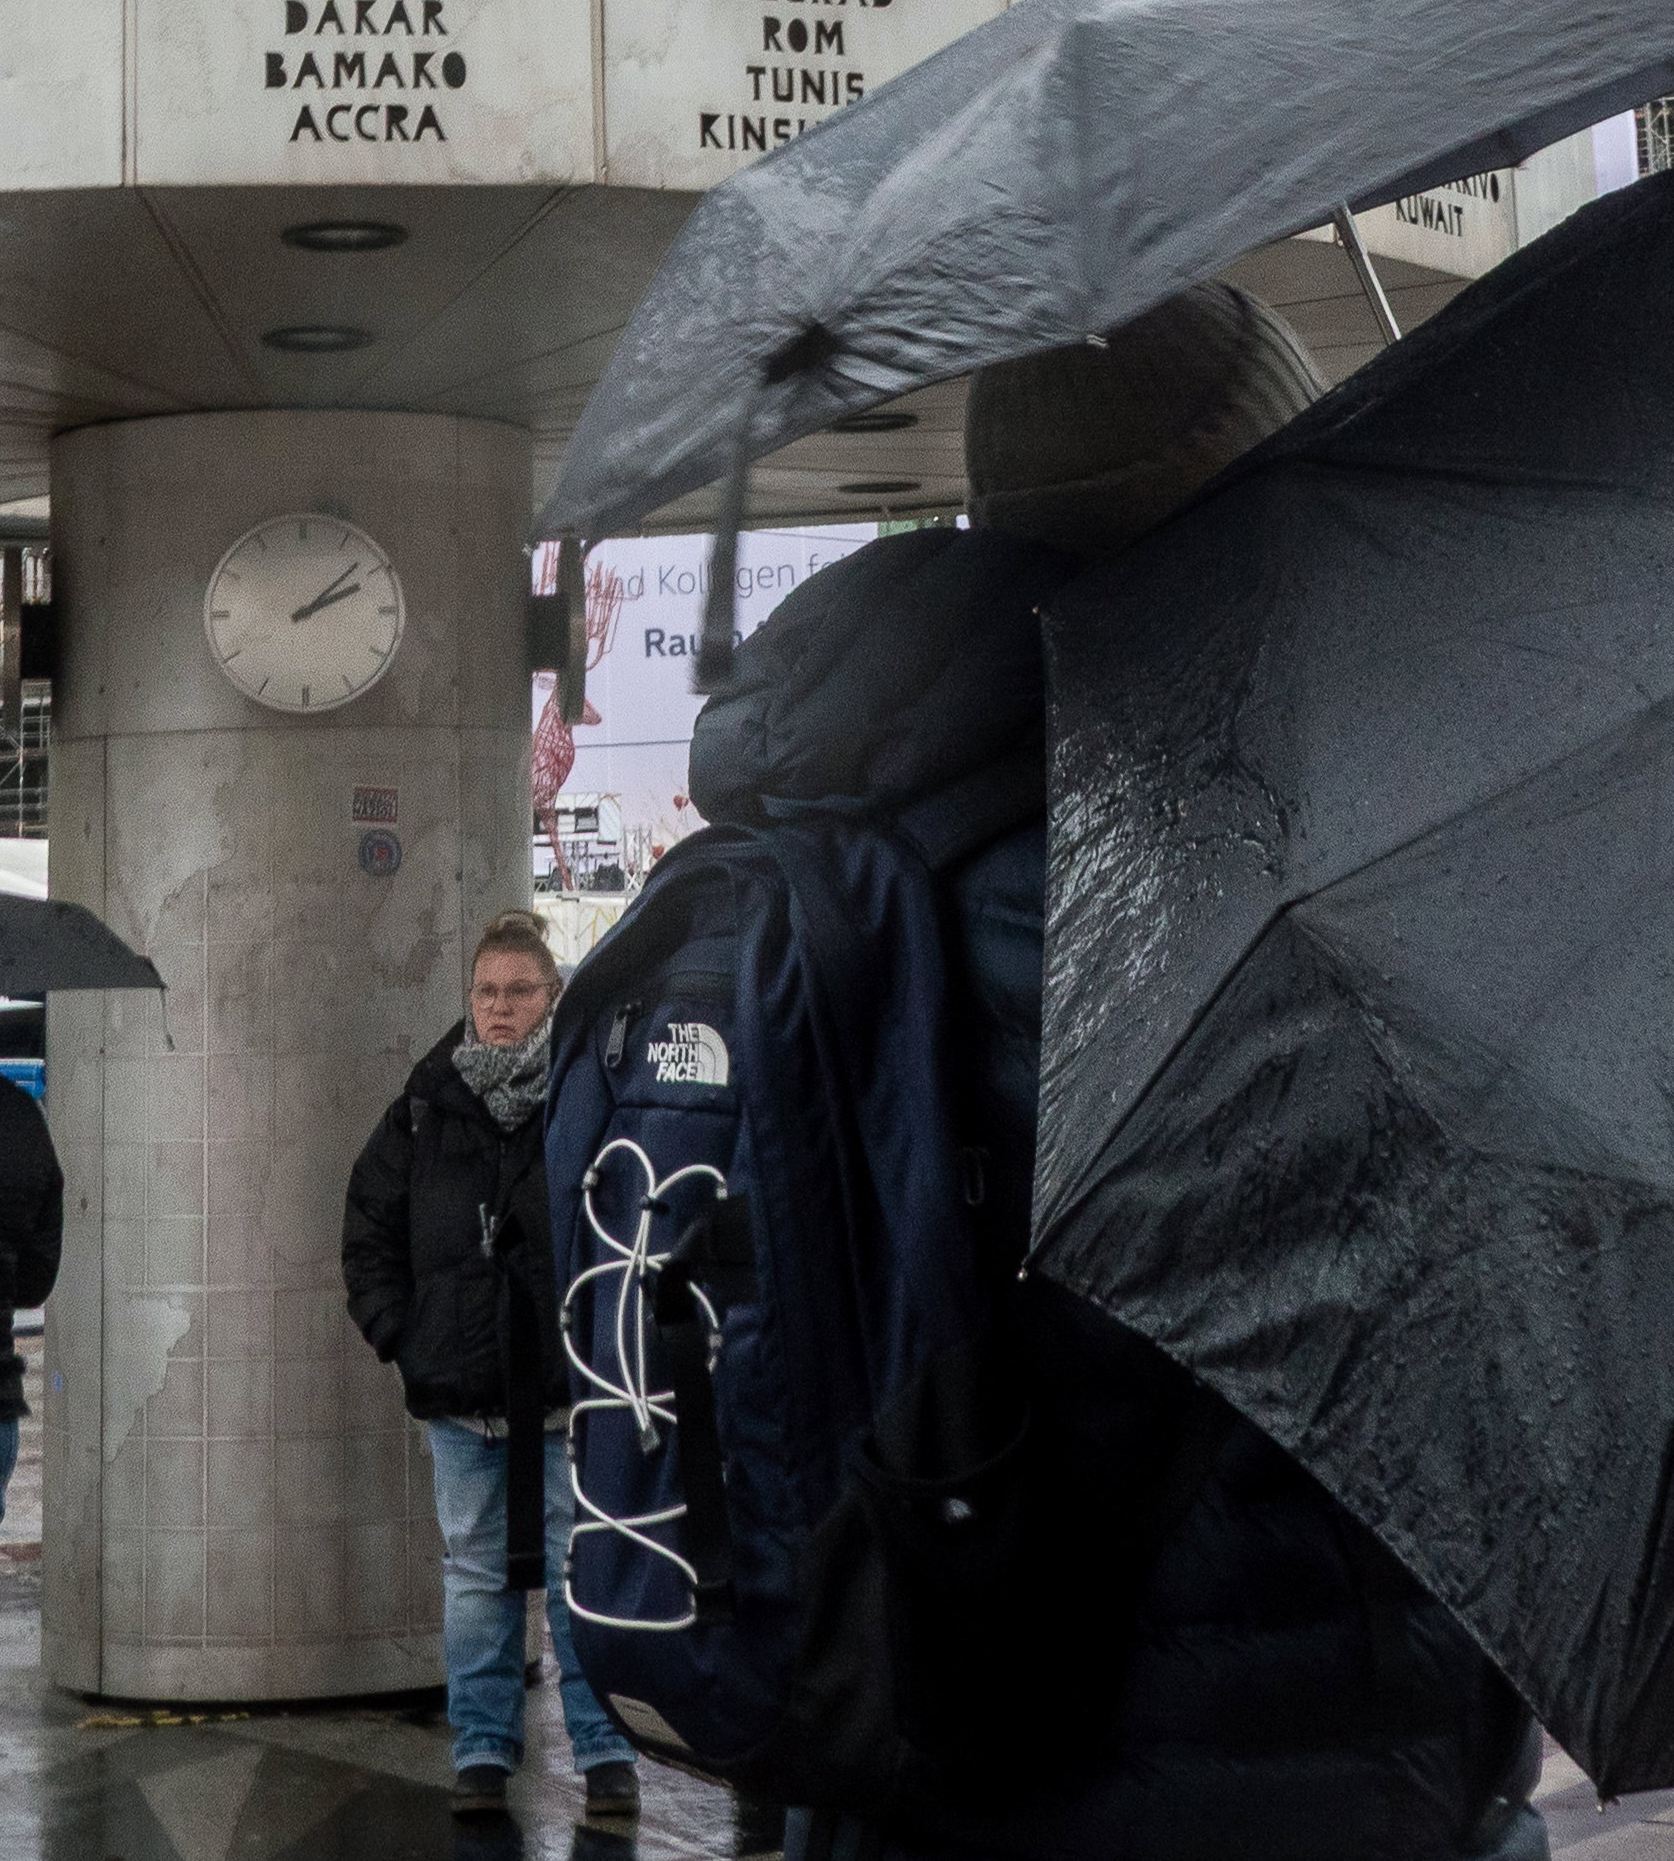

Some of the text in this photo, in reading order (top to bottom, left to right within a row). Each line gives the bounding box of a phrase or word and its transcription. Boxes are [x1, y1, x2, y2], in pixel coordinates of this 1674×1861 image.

[763, 16, 844, 55] ROM
[264, 51, 466, 89] BAMAKO
[746, 65, 864, 107] TUNIS
[288, 104, 447, 142] ACCRA
[1396, 195, 1463, 236] KUWAIT
[667, 1023, 699, 1043] THE
[648, 1042, 698, 1063] NORTH
[656, 1062, 697, 1083] FACE
